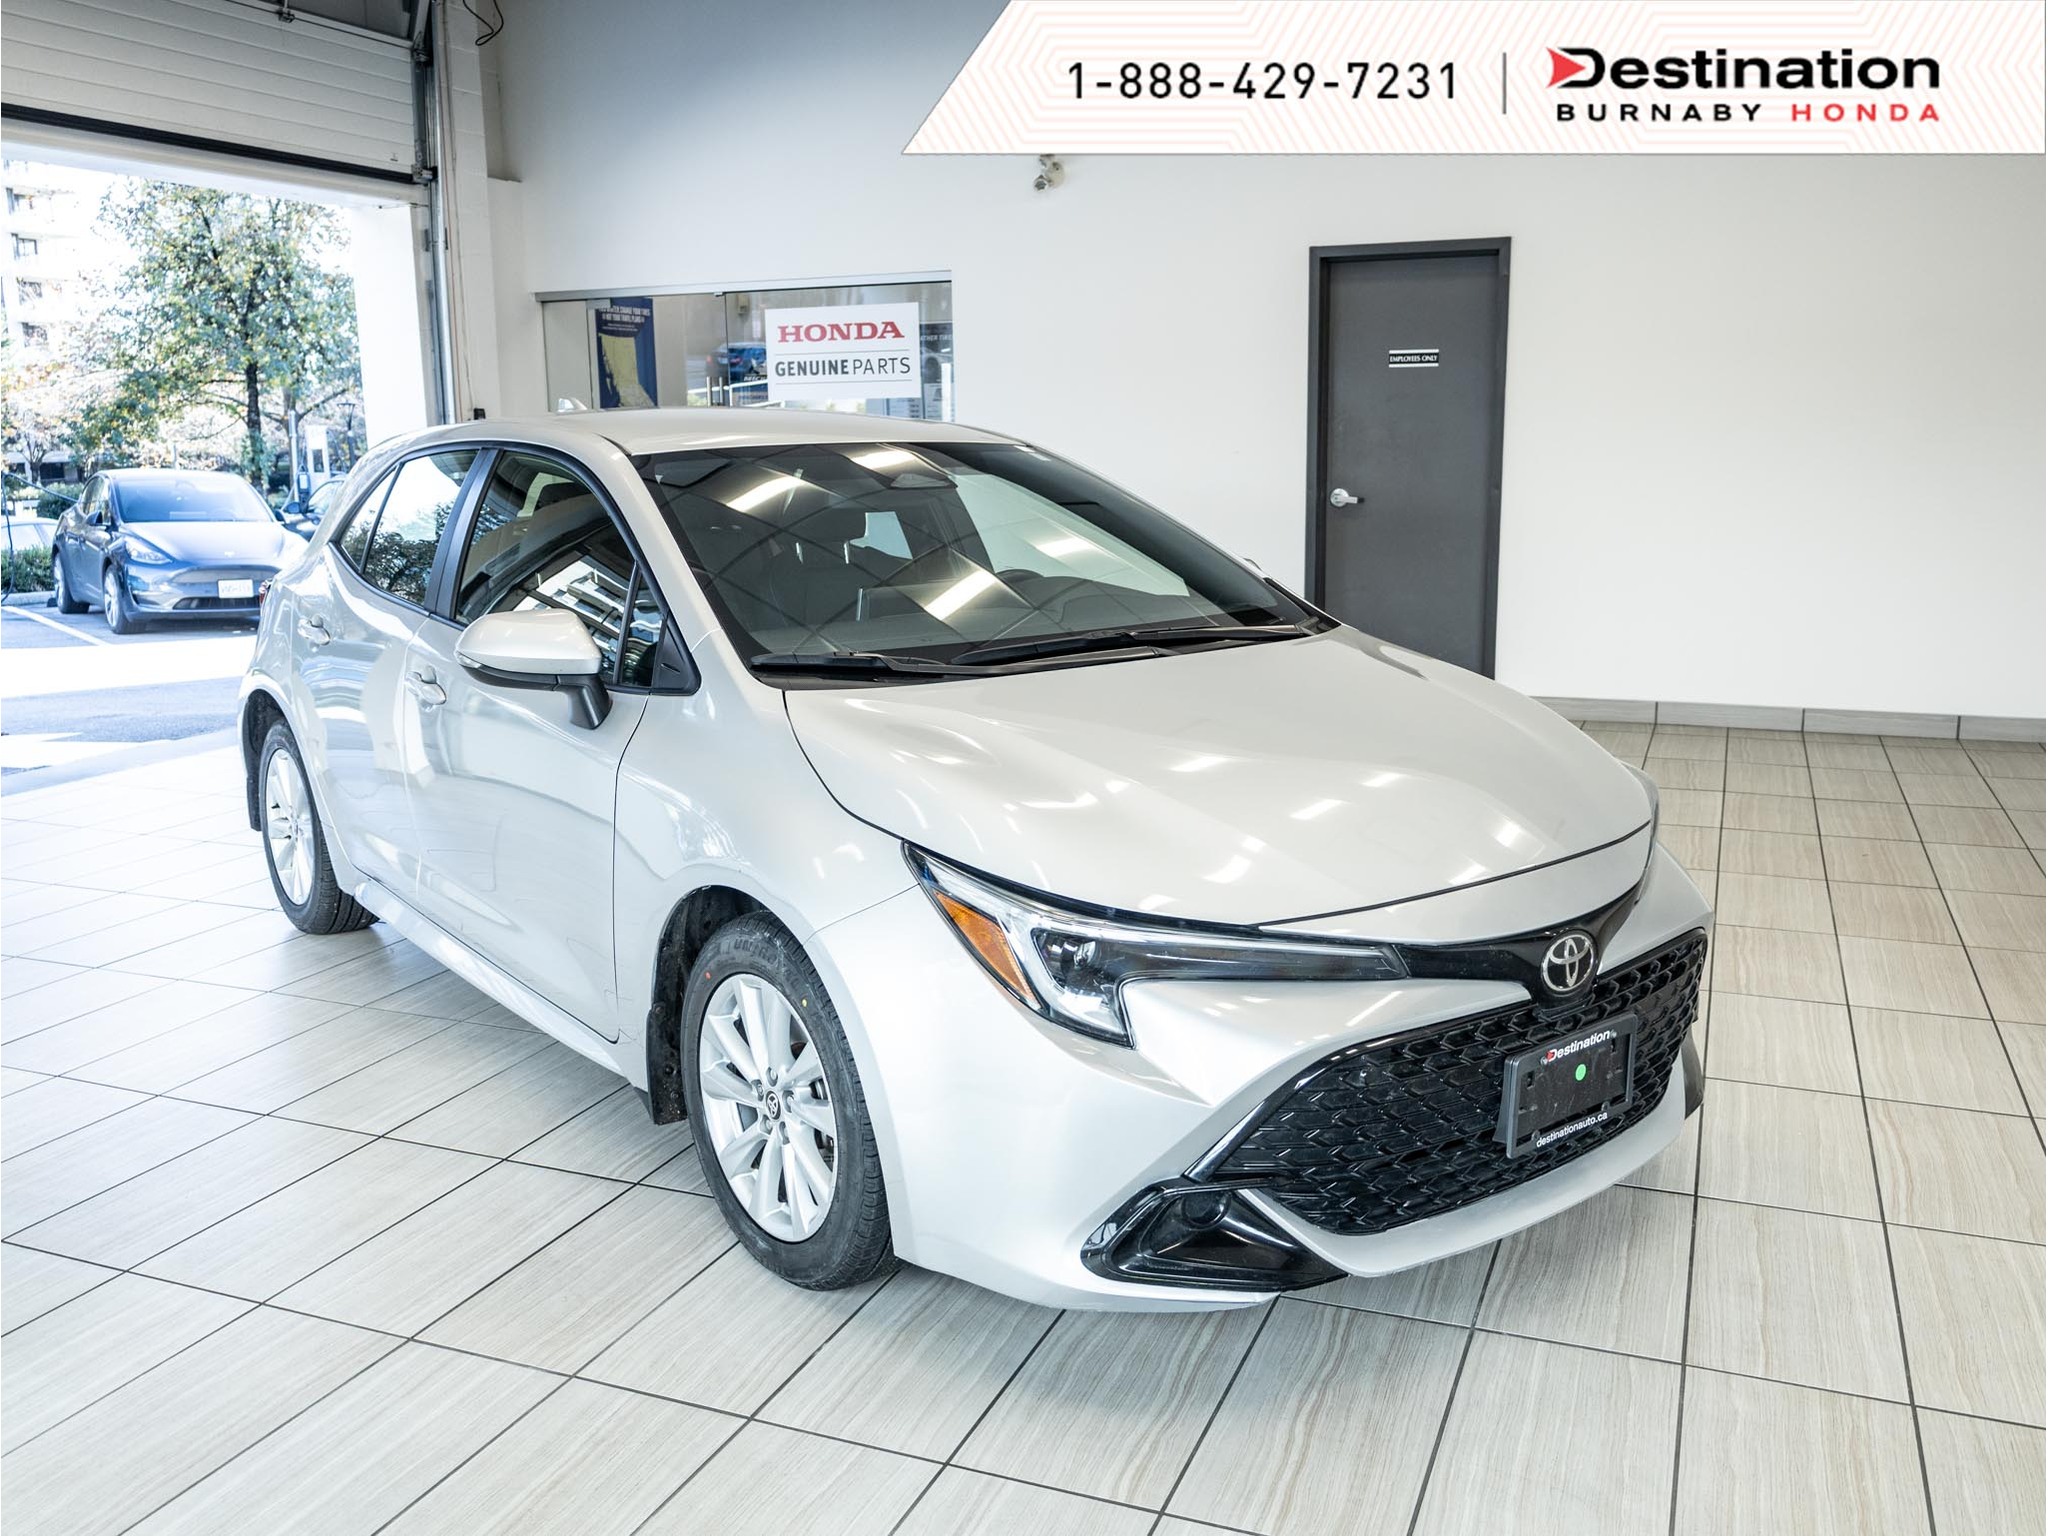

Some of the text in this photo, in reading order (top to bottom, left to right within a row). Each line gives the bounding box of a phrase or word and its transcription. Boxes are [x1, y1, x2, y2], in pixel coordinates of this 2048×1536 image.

[777, 321, 905, 343] HONDA
[775, 357, 911, 377] GENUINE PARTS
[1421, 354, 1438, 362] ONLY
[1546, 1030, 1610, 1061] Destination
[1536, 1112, 1608, 1148] destinationauto.ca
